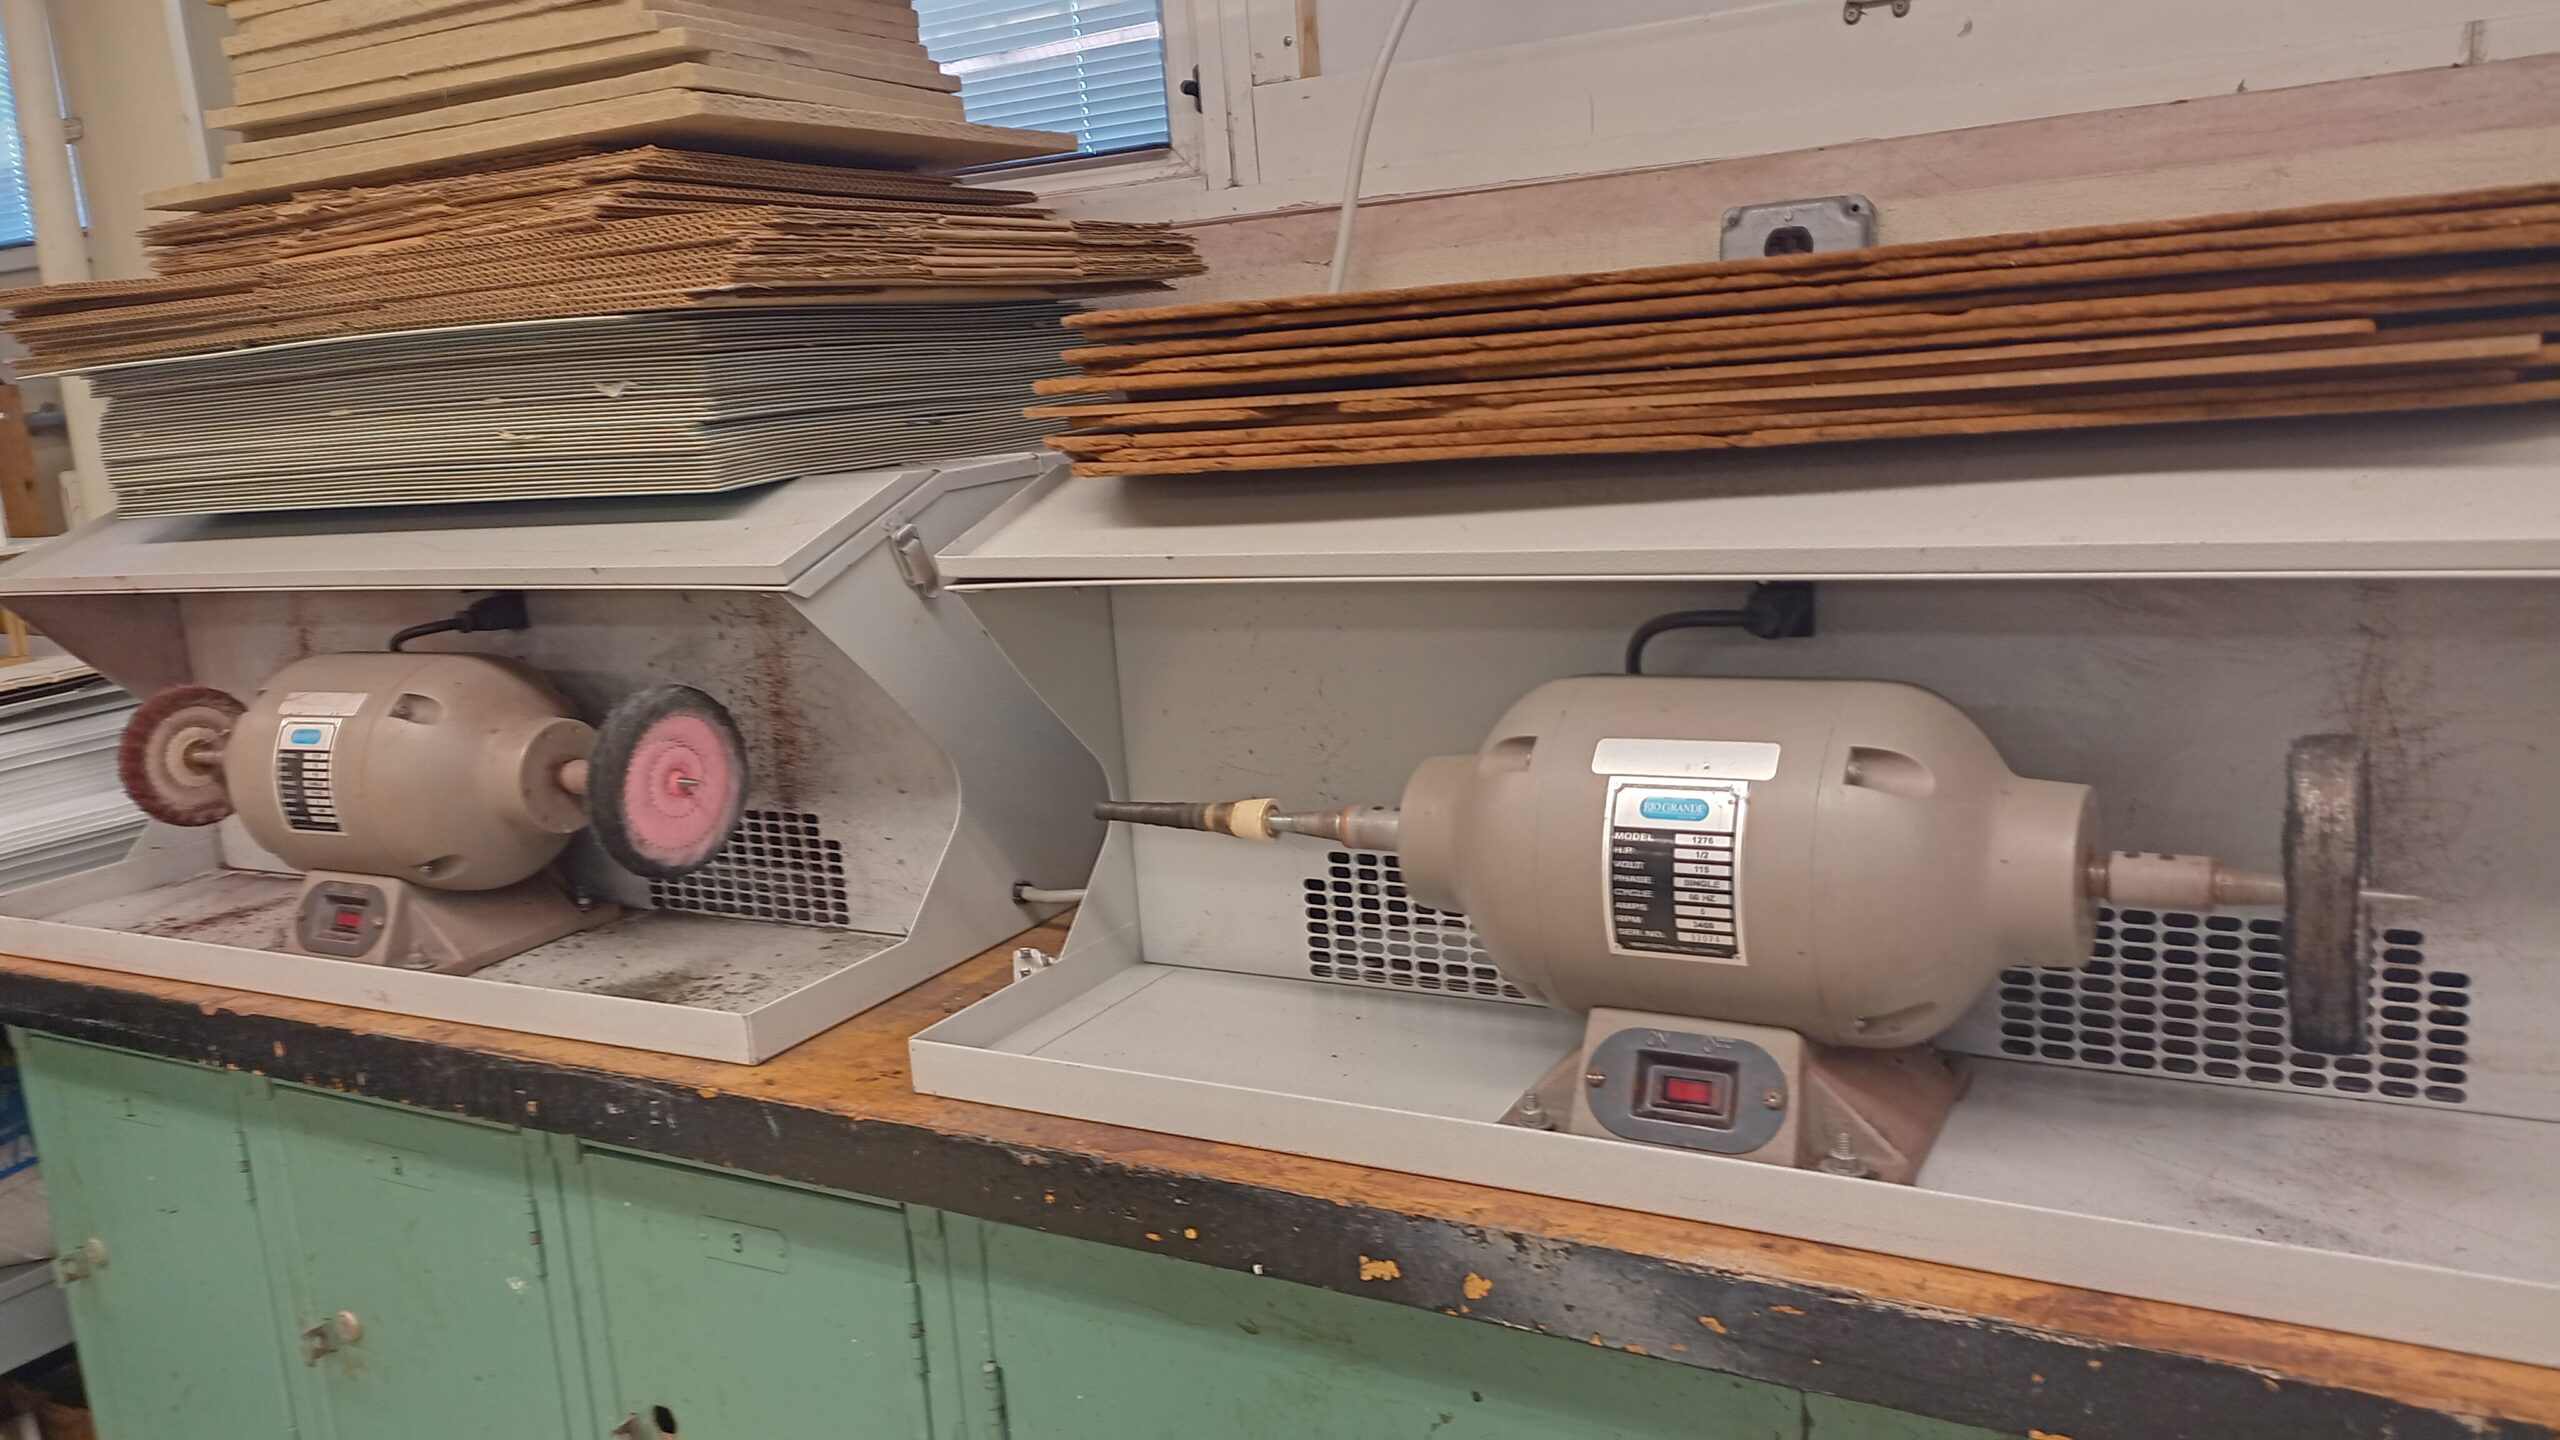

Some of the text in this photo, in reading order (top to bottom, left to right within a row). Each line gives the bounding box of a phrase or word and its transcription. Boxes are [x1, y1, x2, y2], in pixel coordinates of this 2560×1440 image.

[1643, 801, 1703, 814] RIO GRANDE
[1614, 832, 1654, 842] MODEL
[1692, 836, 1714, 844] 1276
[1696, 851, 1709, 859] 1/2
[1694, 865, 1710, 873] 115
[1614, 874, 1654, 884] PHASE
[1684, 879, 1720, 888] SINGLE
[1614, 888, 1654, 897] CYCLE
[1615, 902, 1649, 911] AMPS
[1616, 915, 1643, 924] RPM
[730, 1233, 744, 1253] 3
